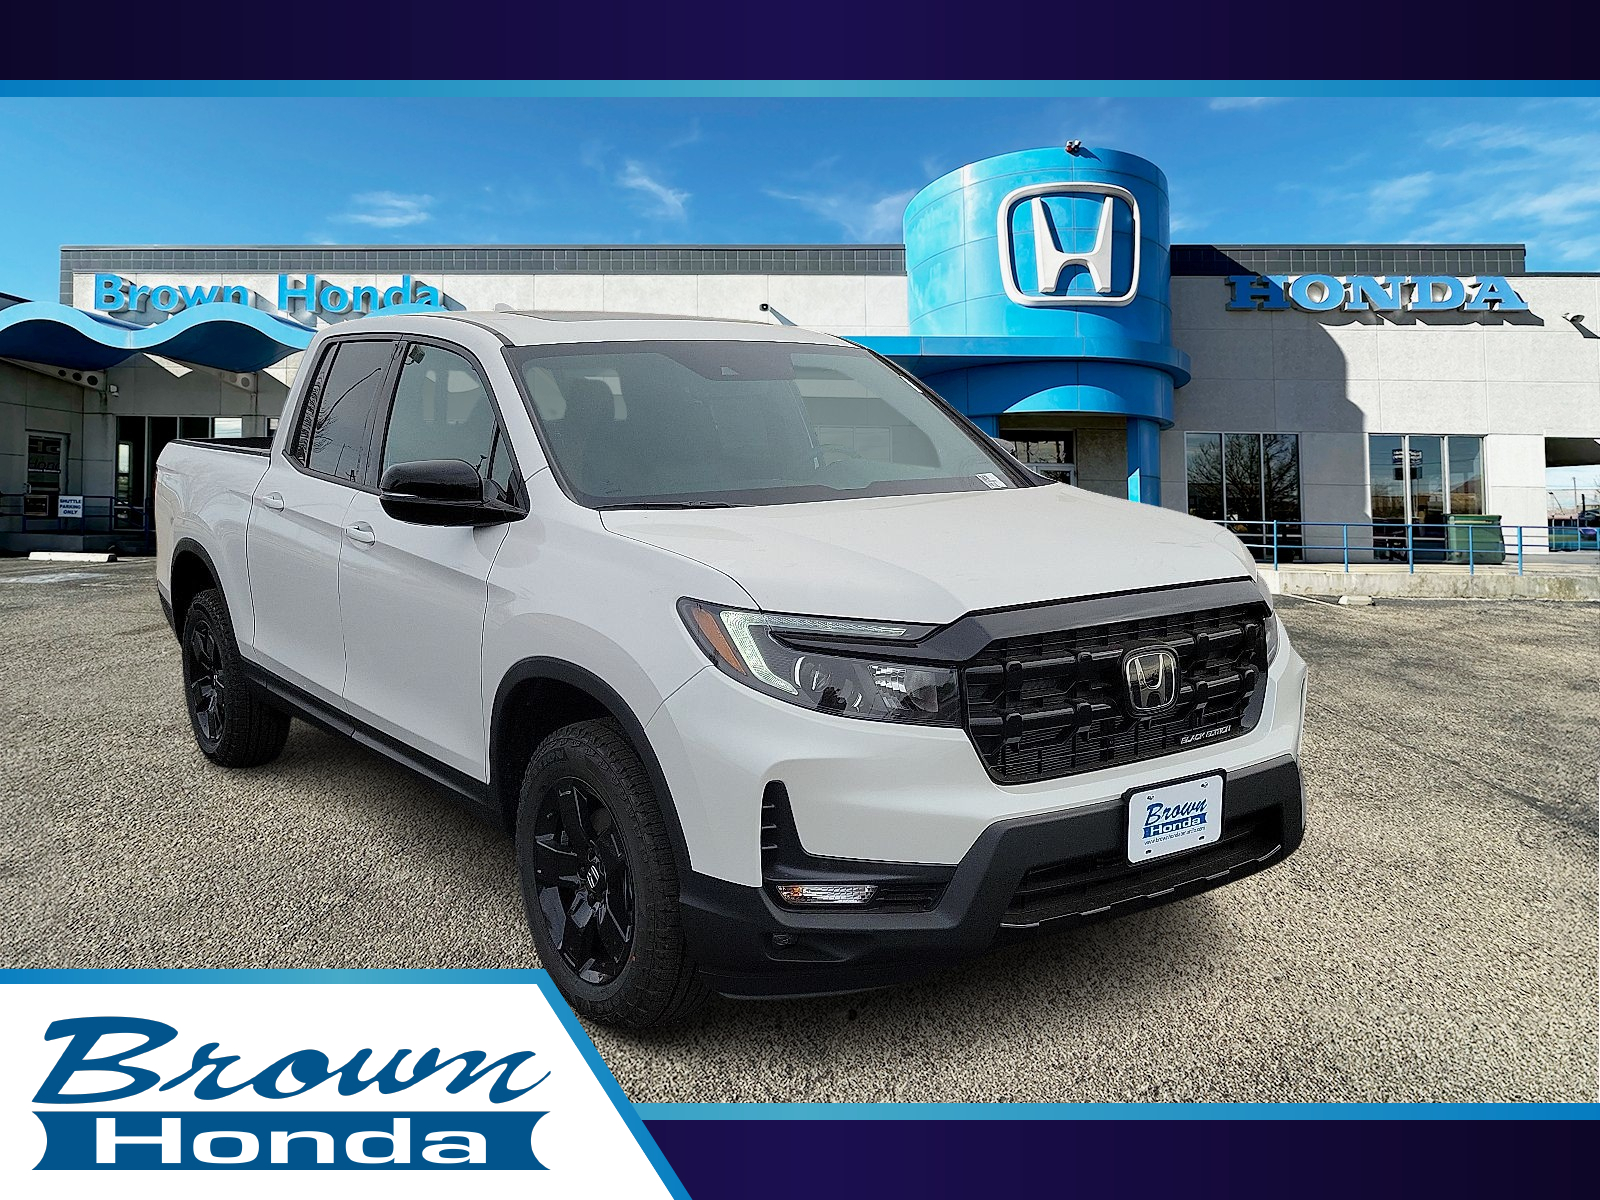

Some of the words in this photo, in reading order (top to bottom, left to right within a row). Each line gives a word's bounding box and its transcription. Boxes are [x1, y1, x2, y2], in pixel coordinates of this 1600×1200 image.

[95, 273, 248, 311] Brown
[278, 274, 439, 312] Honda
[1226, 274, 1529, 312] HONDA
[1180, 732, 1205, 745] BLACK
[1144, 798, 1208, 826] Brown
[1150, 817, 1201, 836] Honda
